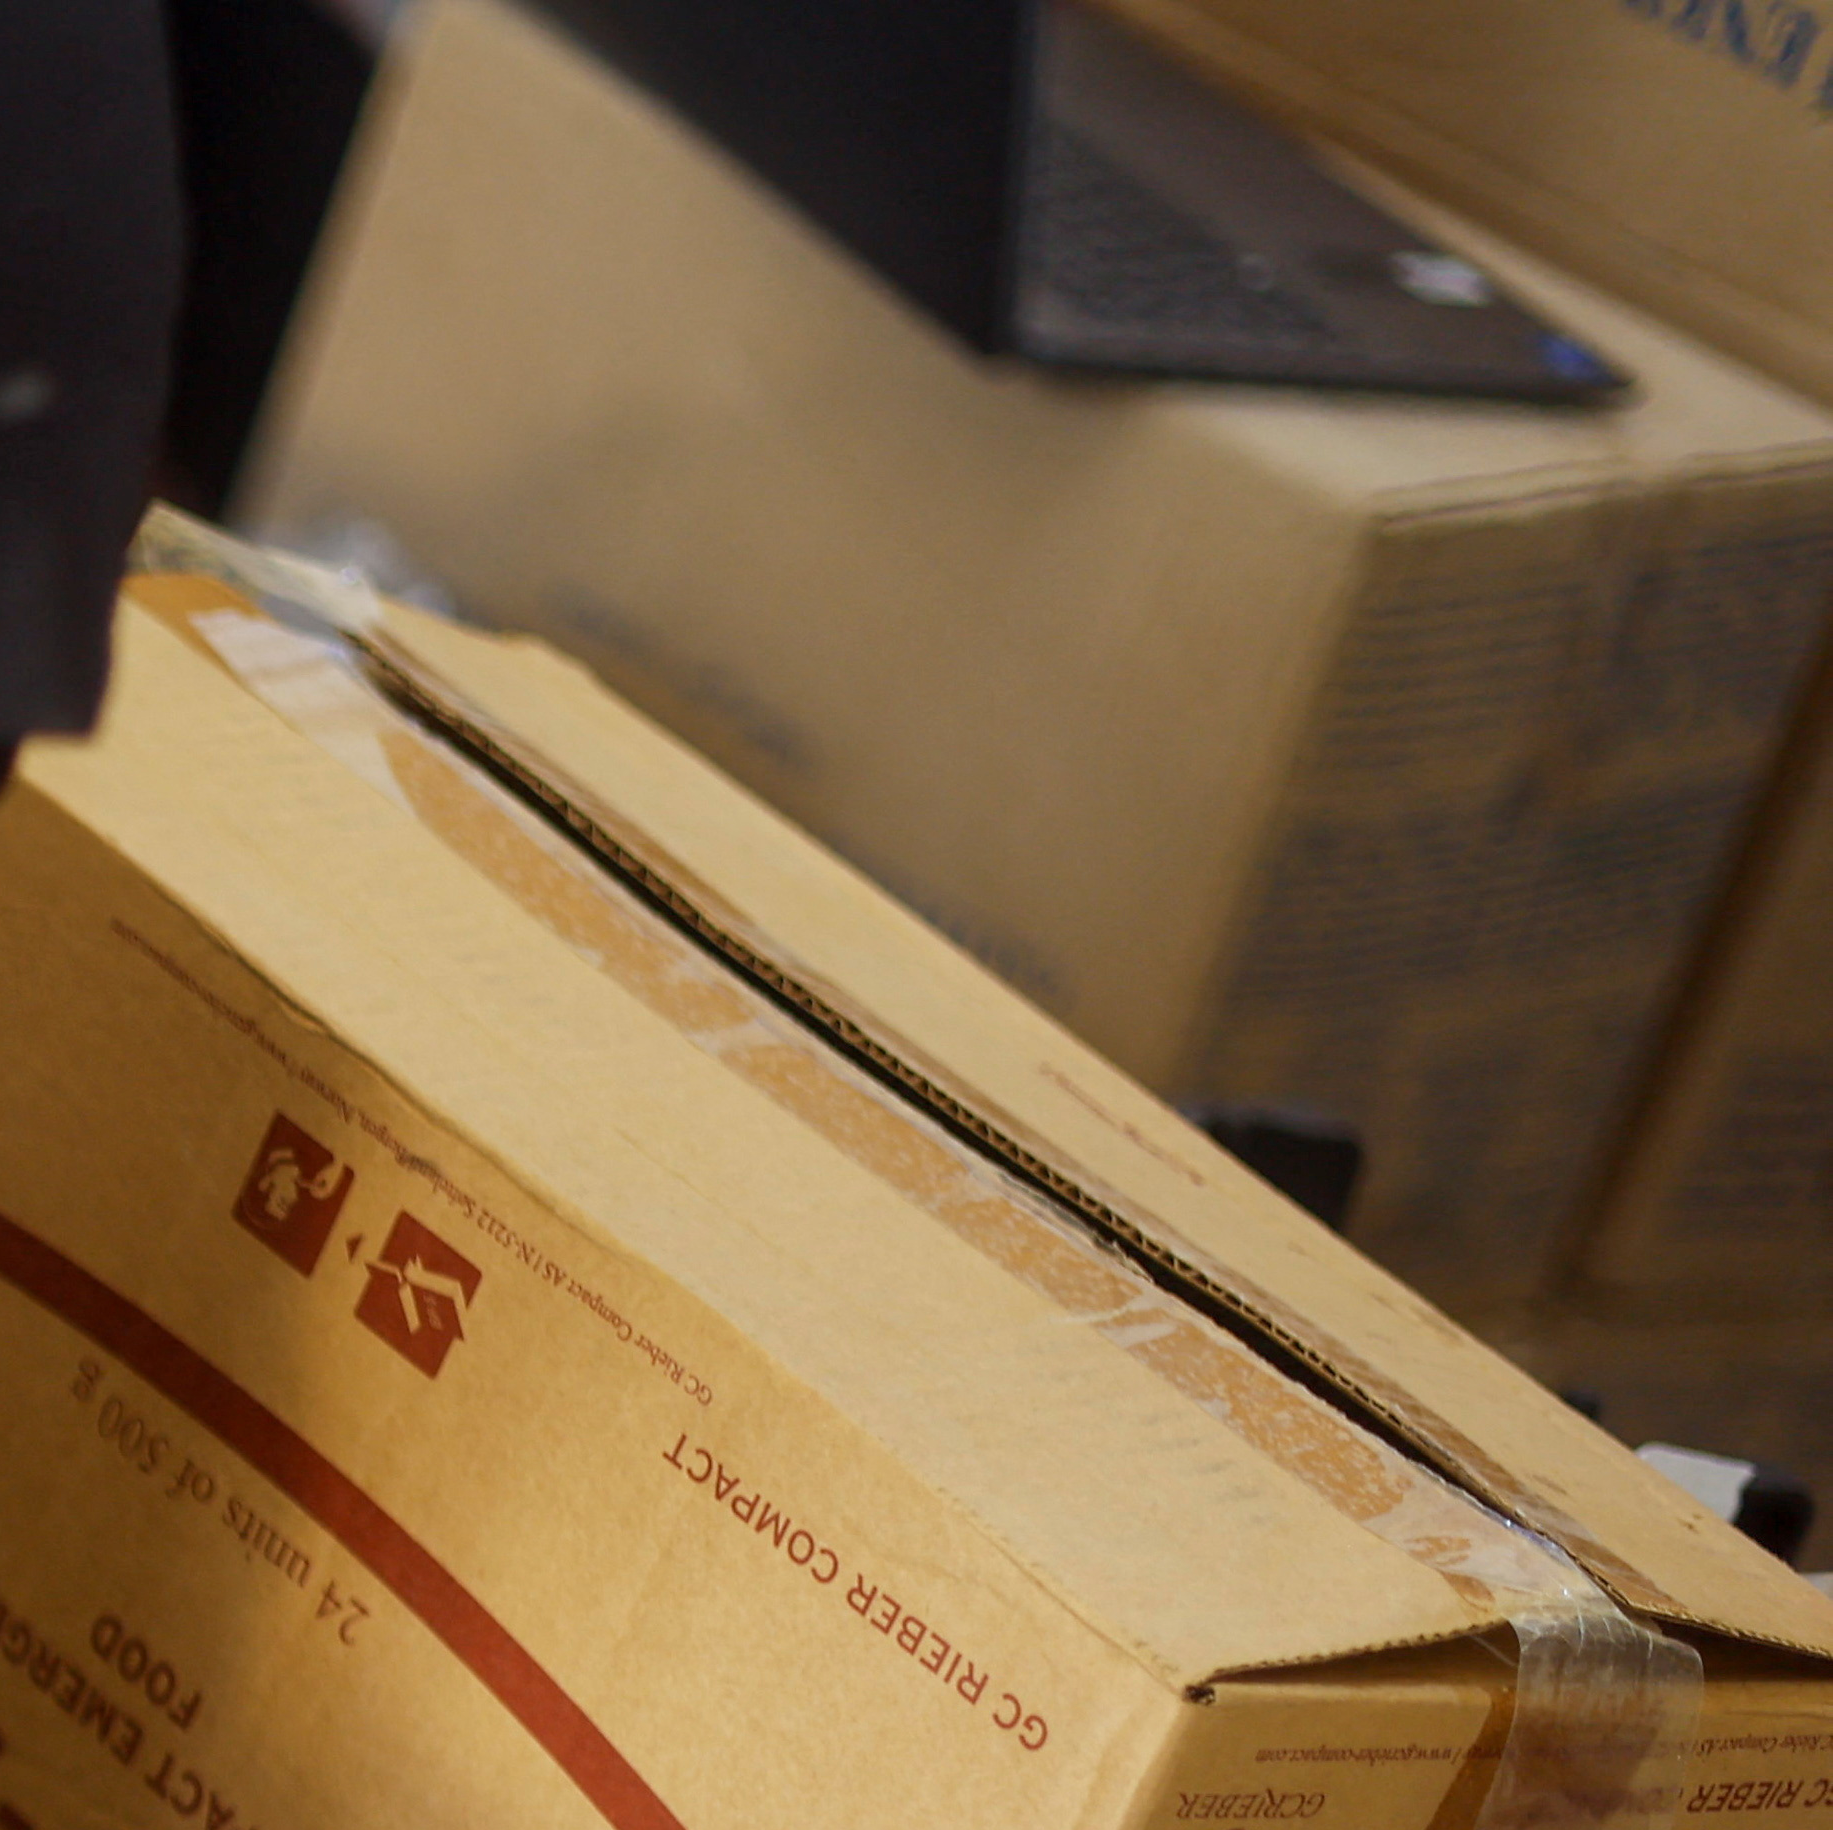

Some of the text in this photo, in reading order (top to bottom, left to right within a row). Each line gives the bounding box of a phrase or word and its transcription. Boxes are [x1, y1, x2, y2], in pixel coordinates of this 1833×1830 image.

[566, 1278, 633, 1342] Compact
[634, 1332, 685, 1382] Rieber
[681, 1375, 713, 1406] GC
[69, 1356, 371, 1648] 24 units of 500 g
[662, 1432, 1049, 1752] GC RIEBER COMPACT
[89, 1614, 204, 1732] FOOD
[1686, 1779, 1805, 1813] RIEBER
